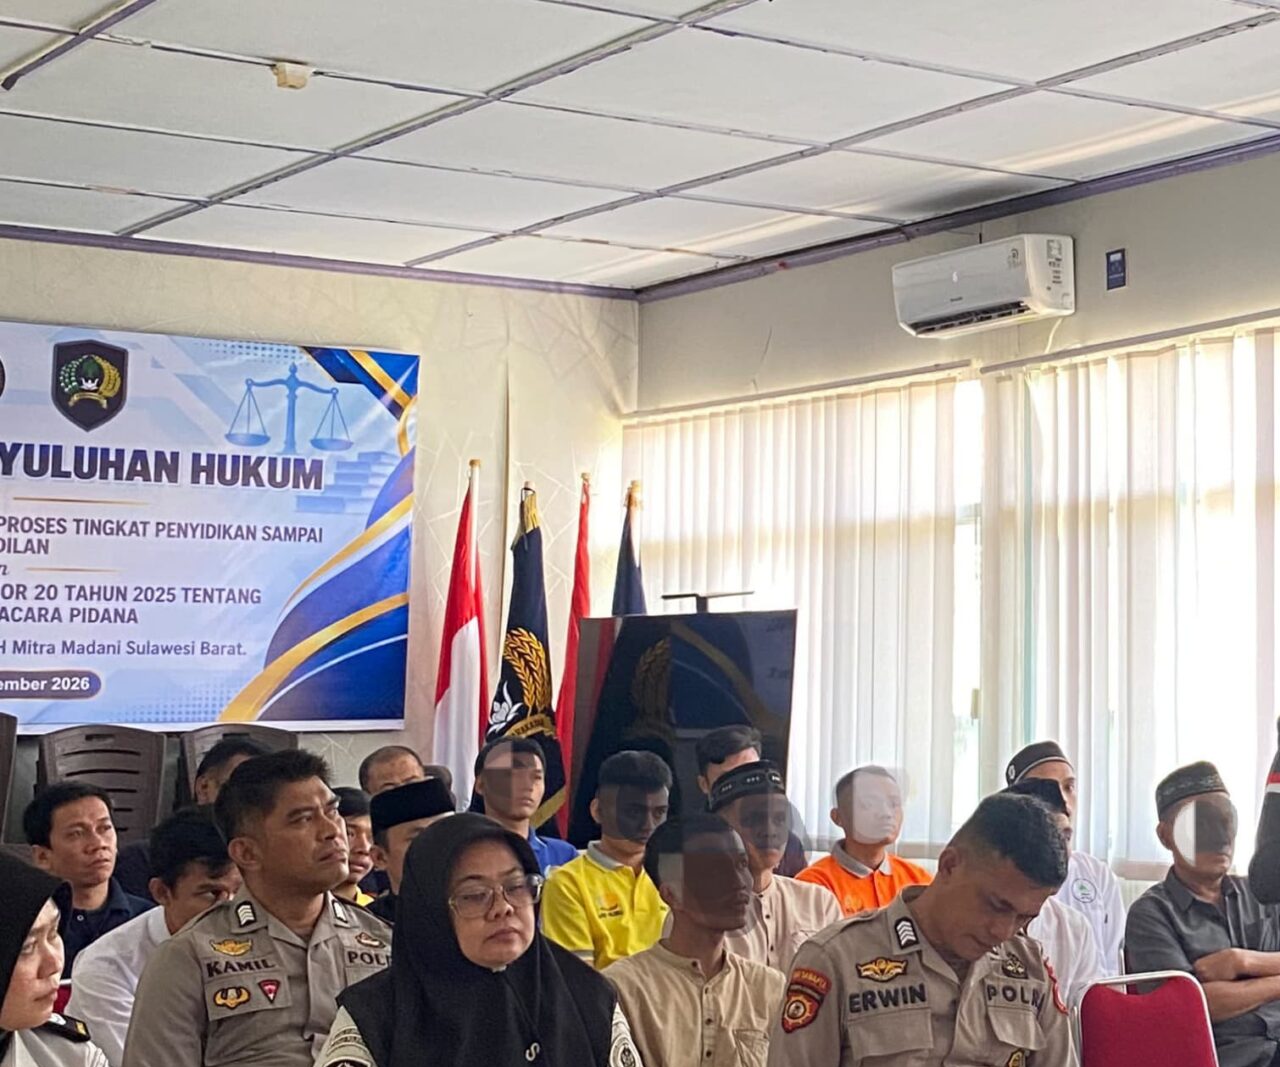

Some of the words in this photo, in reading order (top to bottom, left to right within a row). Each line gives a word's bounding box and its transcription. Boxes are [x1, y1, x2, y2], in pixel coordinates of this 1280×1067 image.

[0, 442, 180, 484] YULUHAN
[190, 452, 324, 490] HUKUM
[73, 518, 150, 537] TINGKAT
[155, 522, 257, 541] PENYIDIKAN
[262, 525, 323, 543] SAMPAI
[1, 583, 27, 600] OR
[34, 584, 58, 600] 20
[64, 585, 128, 602] TAHUN
[132, 586, 176, 603] 2025
[181, 587, 262, 604] TENTANG
[0, 606, 62, 623] ACARA
[69, 607, 139, 624] PIDANA
[12, 640, 55, 655] Mitra
[61, 640, 121, 655] Madani
[126, 640, 196, 655] Sulawesi
[200, 641, 247, 655] Barat.
[51, 677, 90, 691] 2026
[206, 959, 276, 978] KAMIL
[849, 982, 927, 1013] ERWIN
